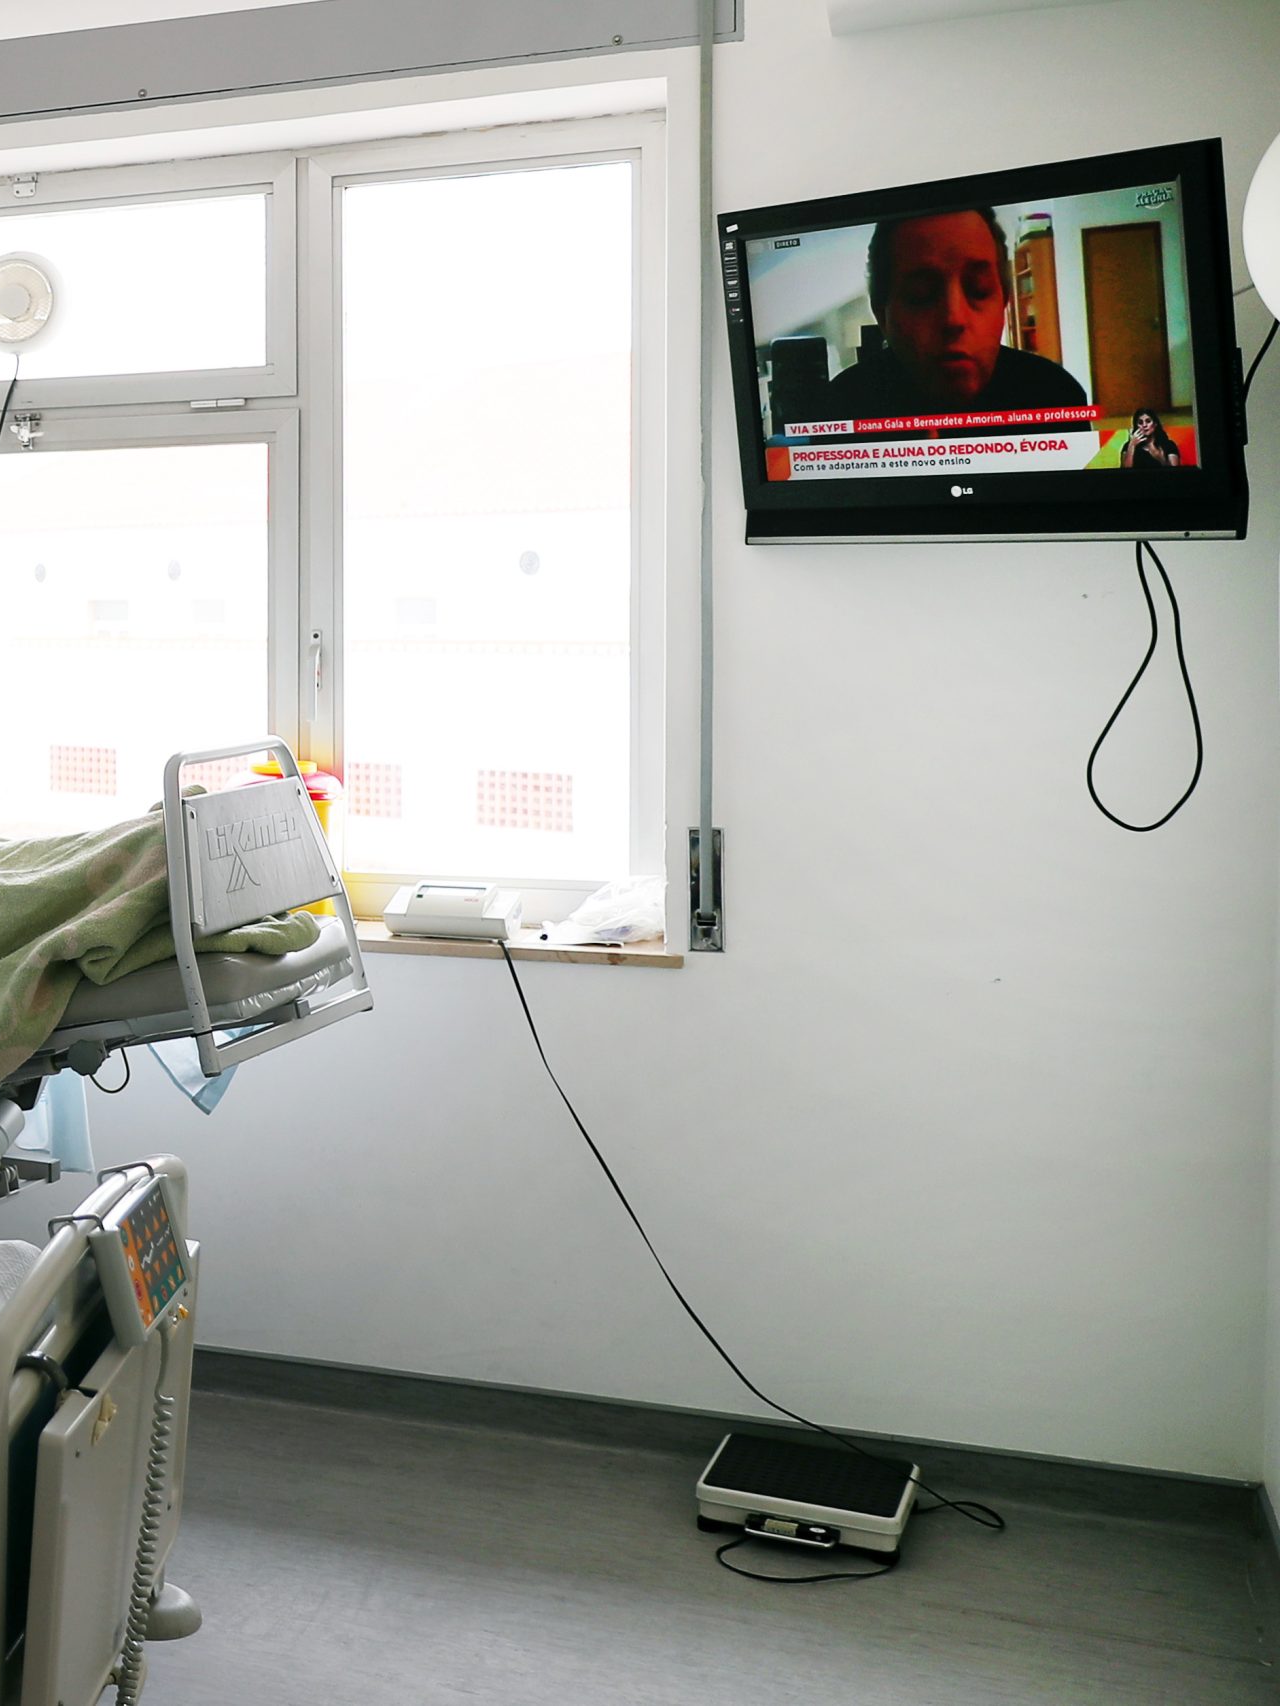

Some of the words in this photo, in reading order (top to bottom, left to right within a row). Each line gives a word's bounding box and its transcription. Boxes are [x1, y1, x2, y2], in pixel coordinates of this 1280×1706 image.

[857, 421, 882, 431] Joana
[913, 416, 963, 428] Bernardete
[965, 413, 1005, 425] Amorim,
[1007, 411, 1033, 422] aluna
[1044, 408, 1097, 421] professora
[790, 425, 809, 434] VIA
[812, 422, 848, 433] SKYPE
[793, 448, 870, 462] PROFESSORA
[872, 448, 880, 459] E
[882, 446, 926, 458] ALUNA
[928, 445, 947, 456] DO
[949, 441, 1018, 455] REDONDO,
[1020, 438, 1068, 452] ÉVORA
[793, 463, 815, 472] Com
[828, 461, 878, 472] adaptaram
[889, 460, 909, 468] este
[938, 457, 971, 467] ensino
[962, 487, 974, 495] LG
